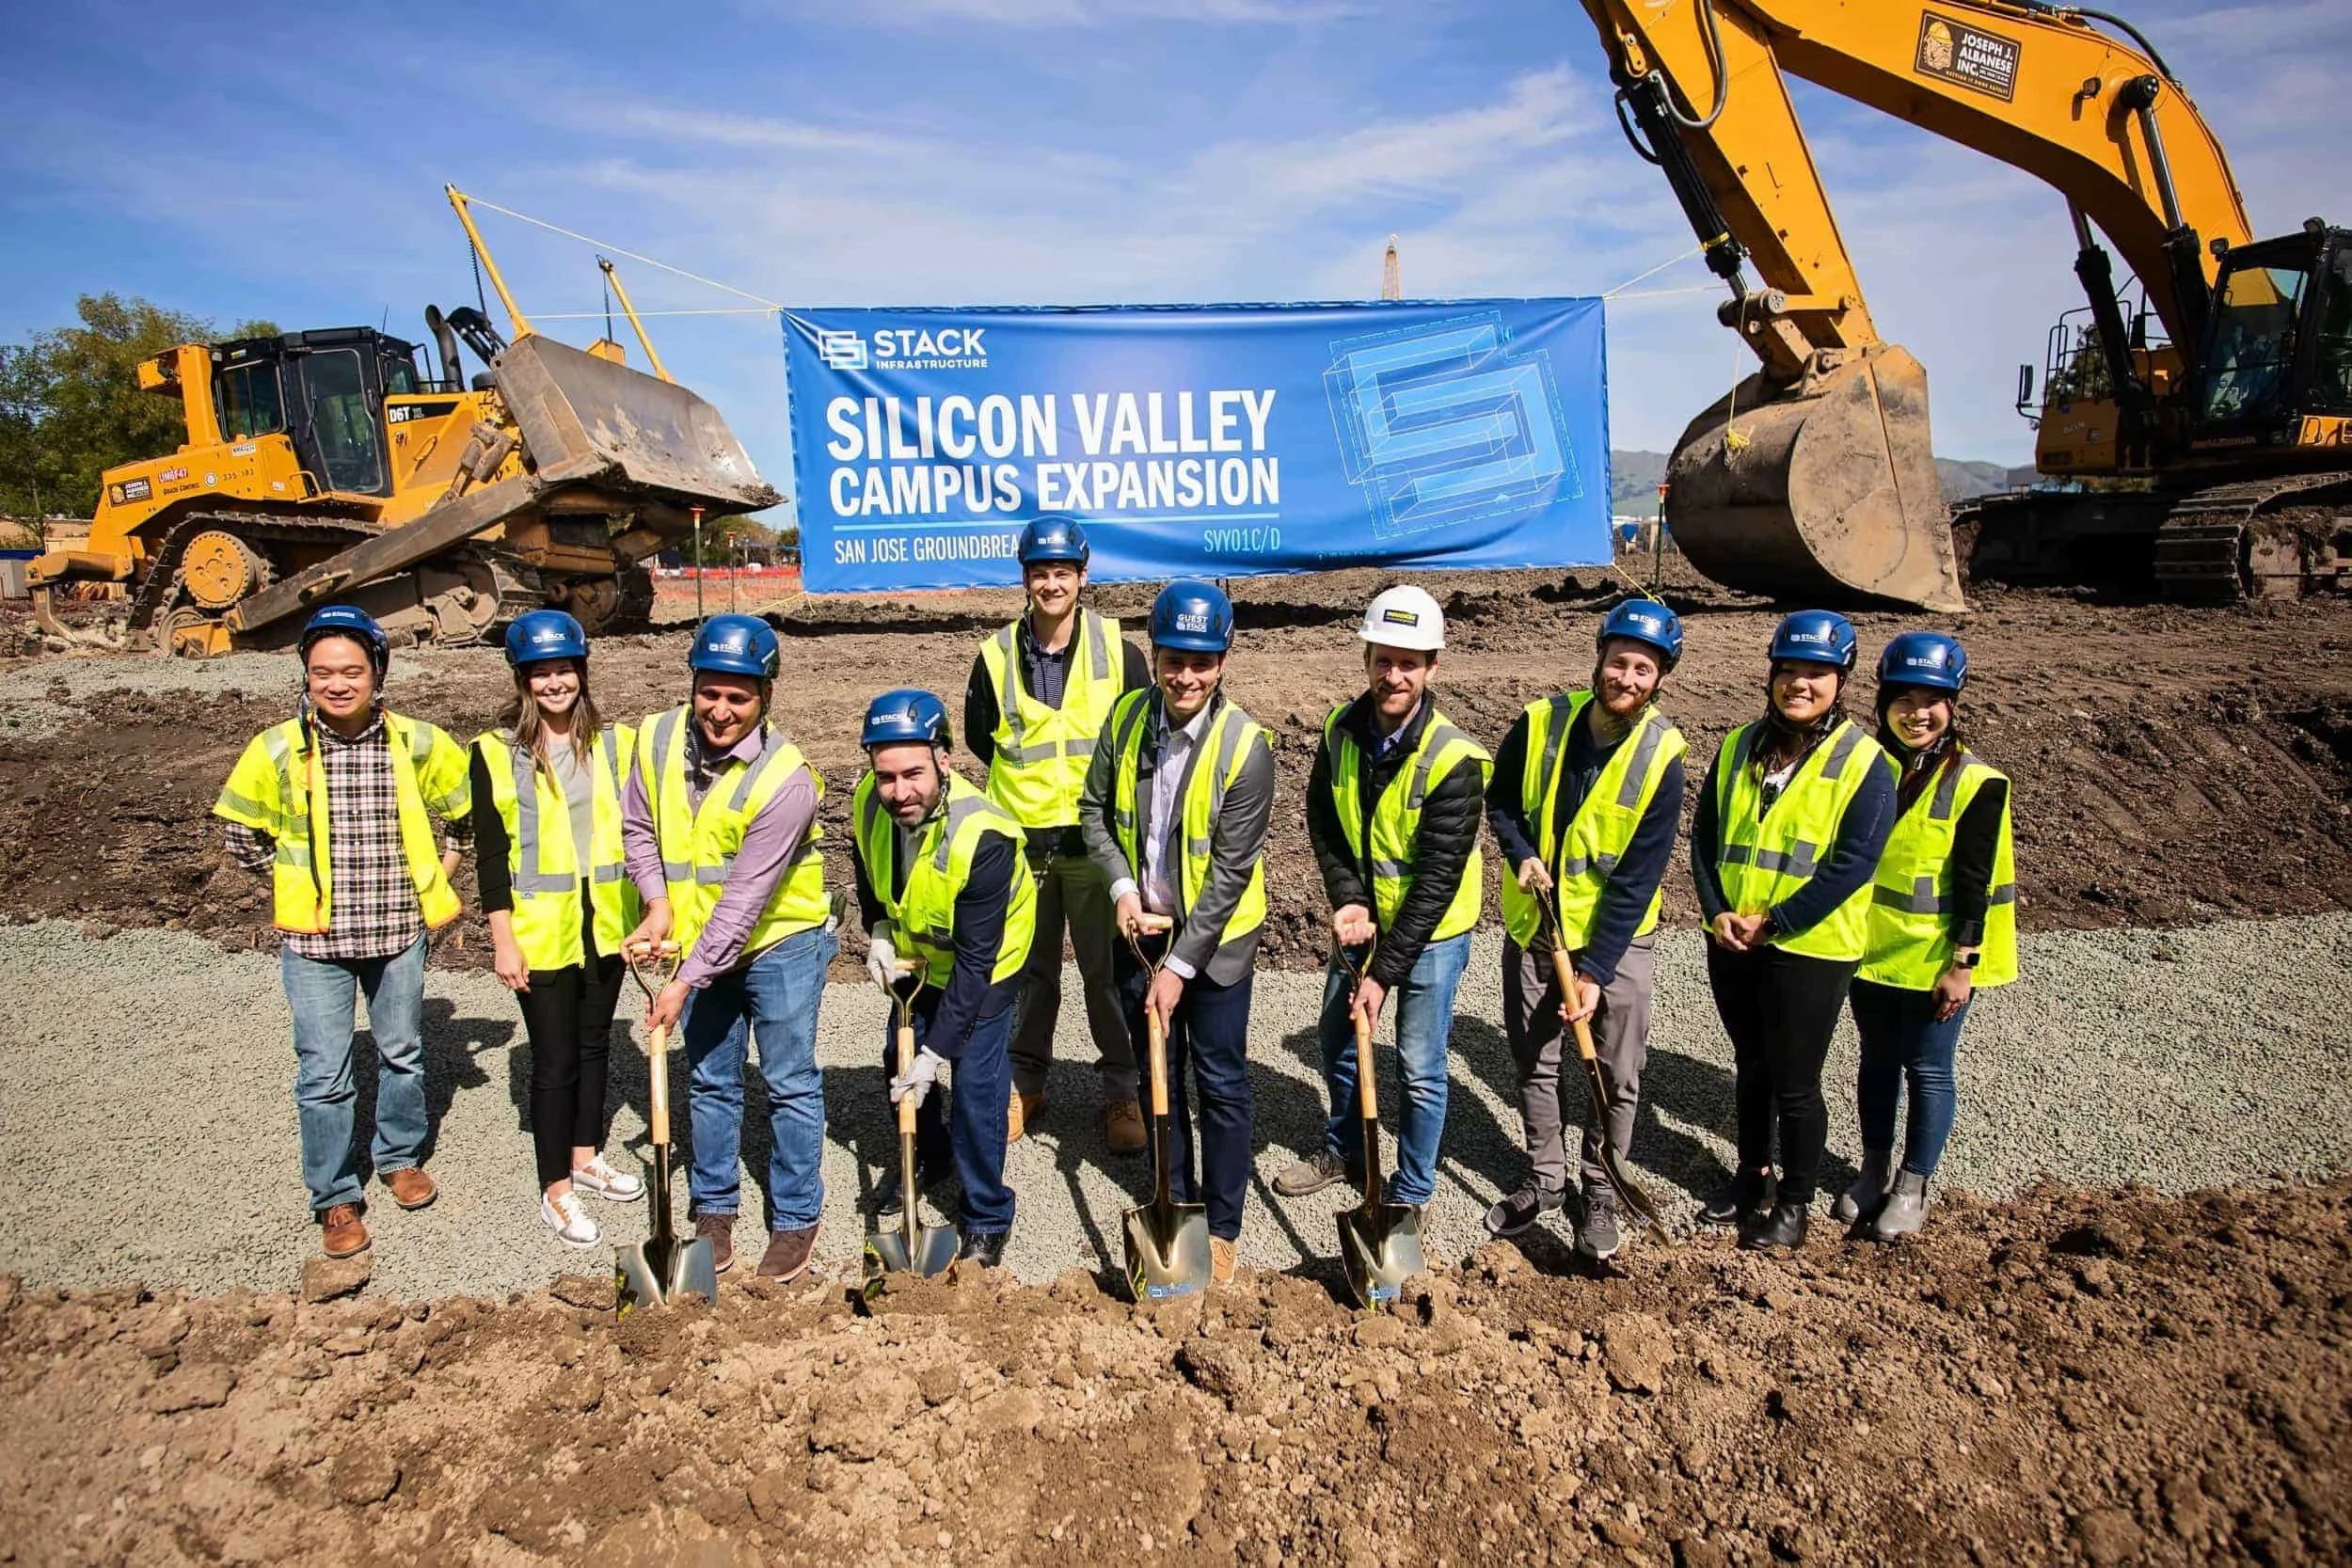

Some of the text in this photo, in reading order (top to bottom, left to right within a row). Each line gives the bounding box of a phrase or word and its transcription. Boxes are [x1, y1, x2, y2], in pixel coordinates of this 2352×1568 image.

[1959, 46, 2013, 73] ALBANESE
[1962, 33, 2013, 61] JOSEPH J.
[1957, 59, 1979, 77] INC.
[874, 329, 987, 357] STACK
[876, 358, 989, 370] INFRASTRUCTURE
[389, 406, 410, 423] D6T
[827, 389, 1278, 461] SILICON VALLEY
[829, 457, 1279, 516] CAMPUS EXPANSION
[834, 533, 1020, 564] SAN JOSE GROUNDBREA
[1178, 613, 1208, 625] GUEST
